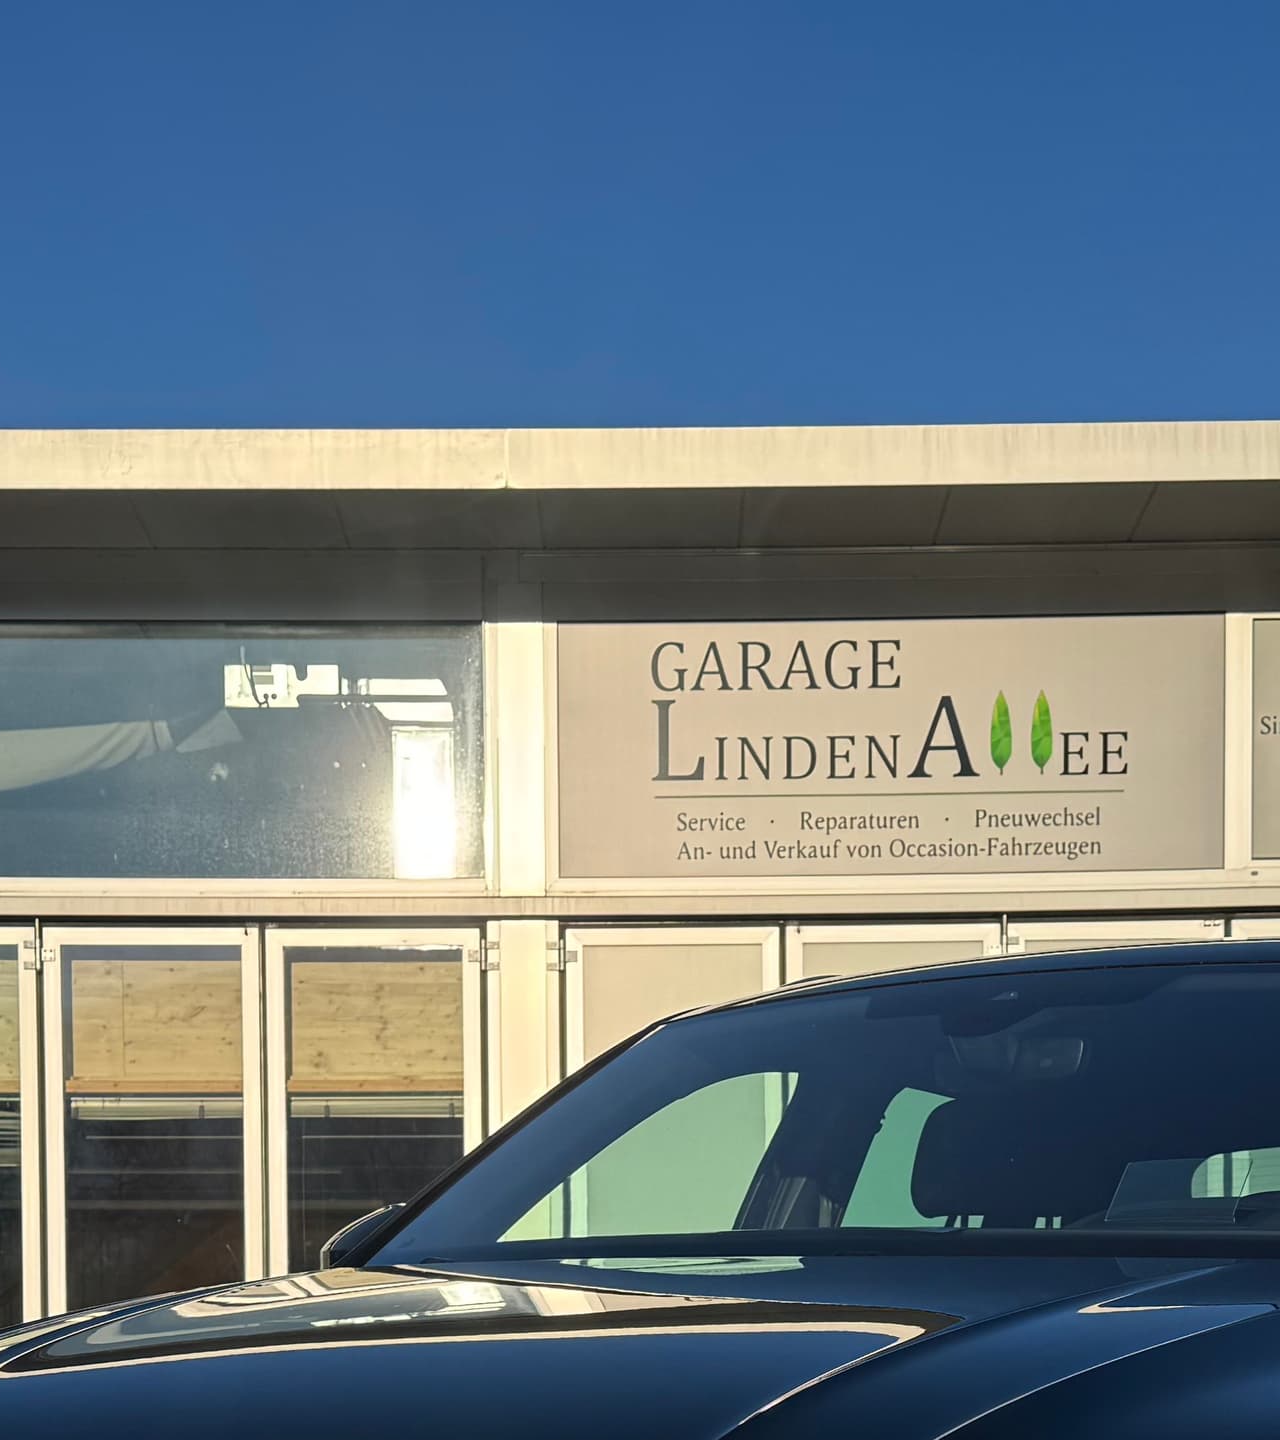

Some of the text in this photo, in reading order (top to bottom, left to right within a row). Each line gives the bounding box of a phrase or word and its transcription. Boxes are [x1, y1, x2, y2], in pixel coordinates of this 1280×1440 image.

[651, 639, 902, 692] GARAGE
[676, 807, 1101, 835] Service Reparaturen Pneuwechsel
[677, 837, 1102, 861] An- und Verkauf von Occasion-Fahrzeugen
